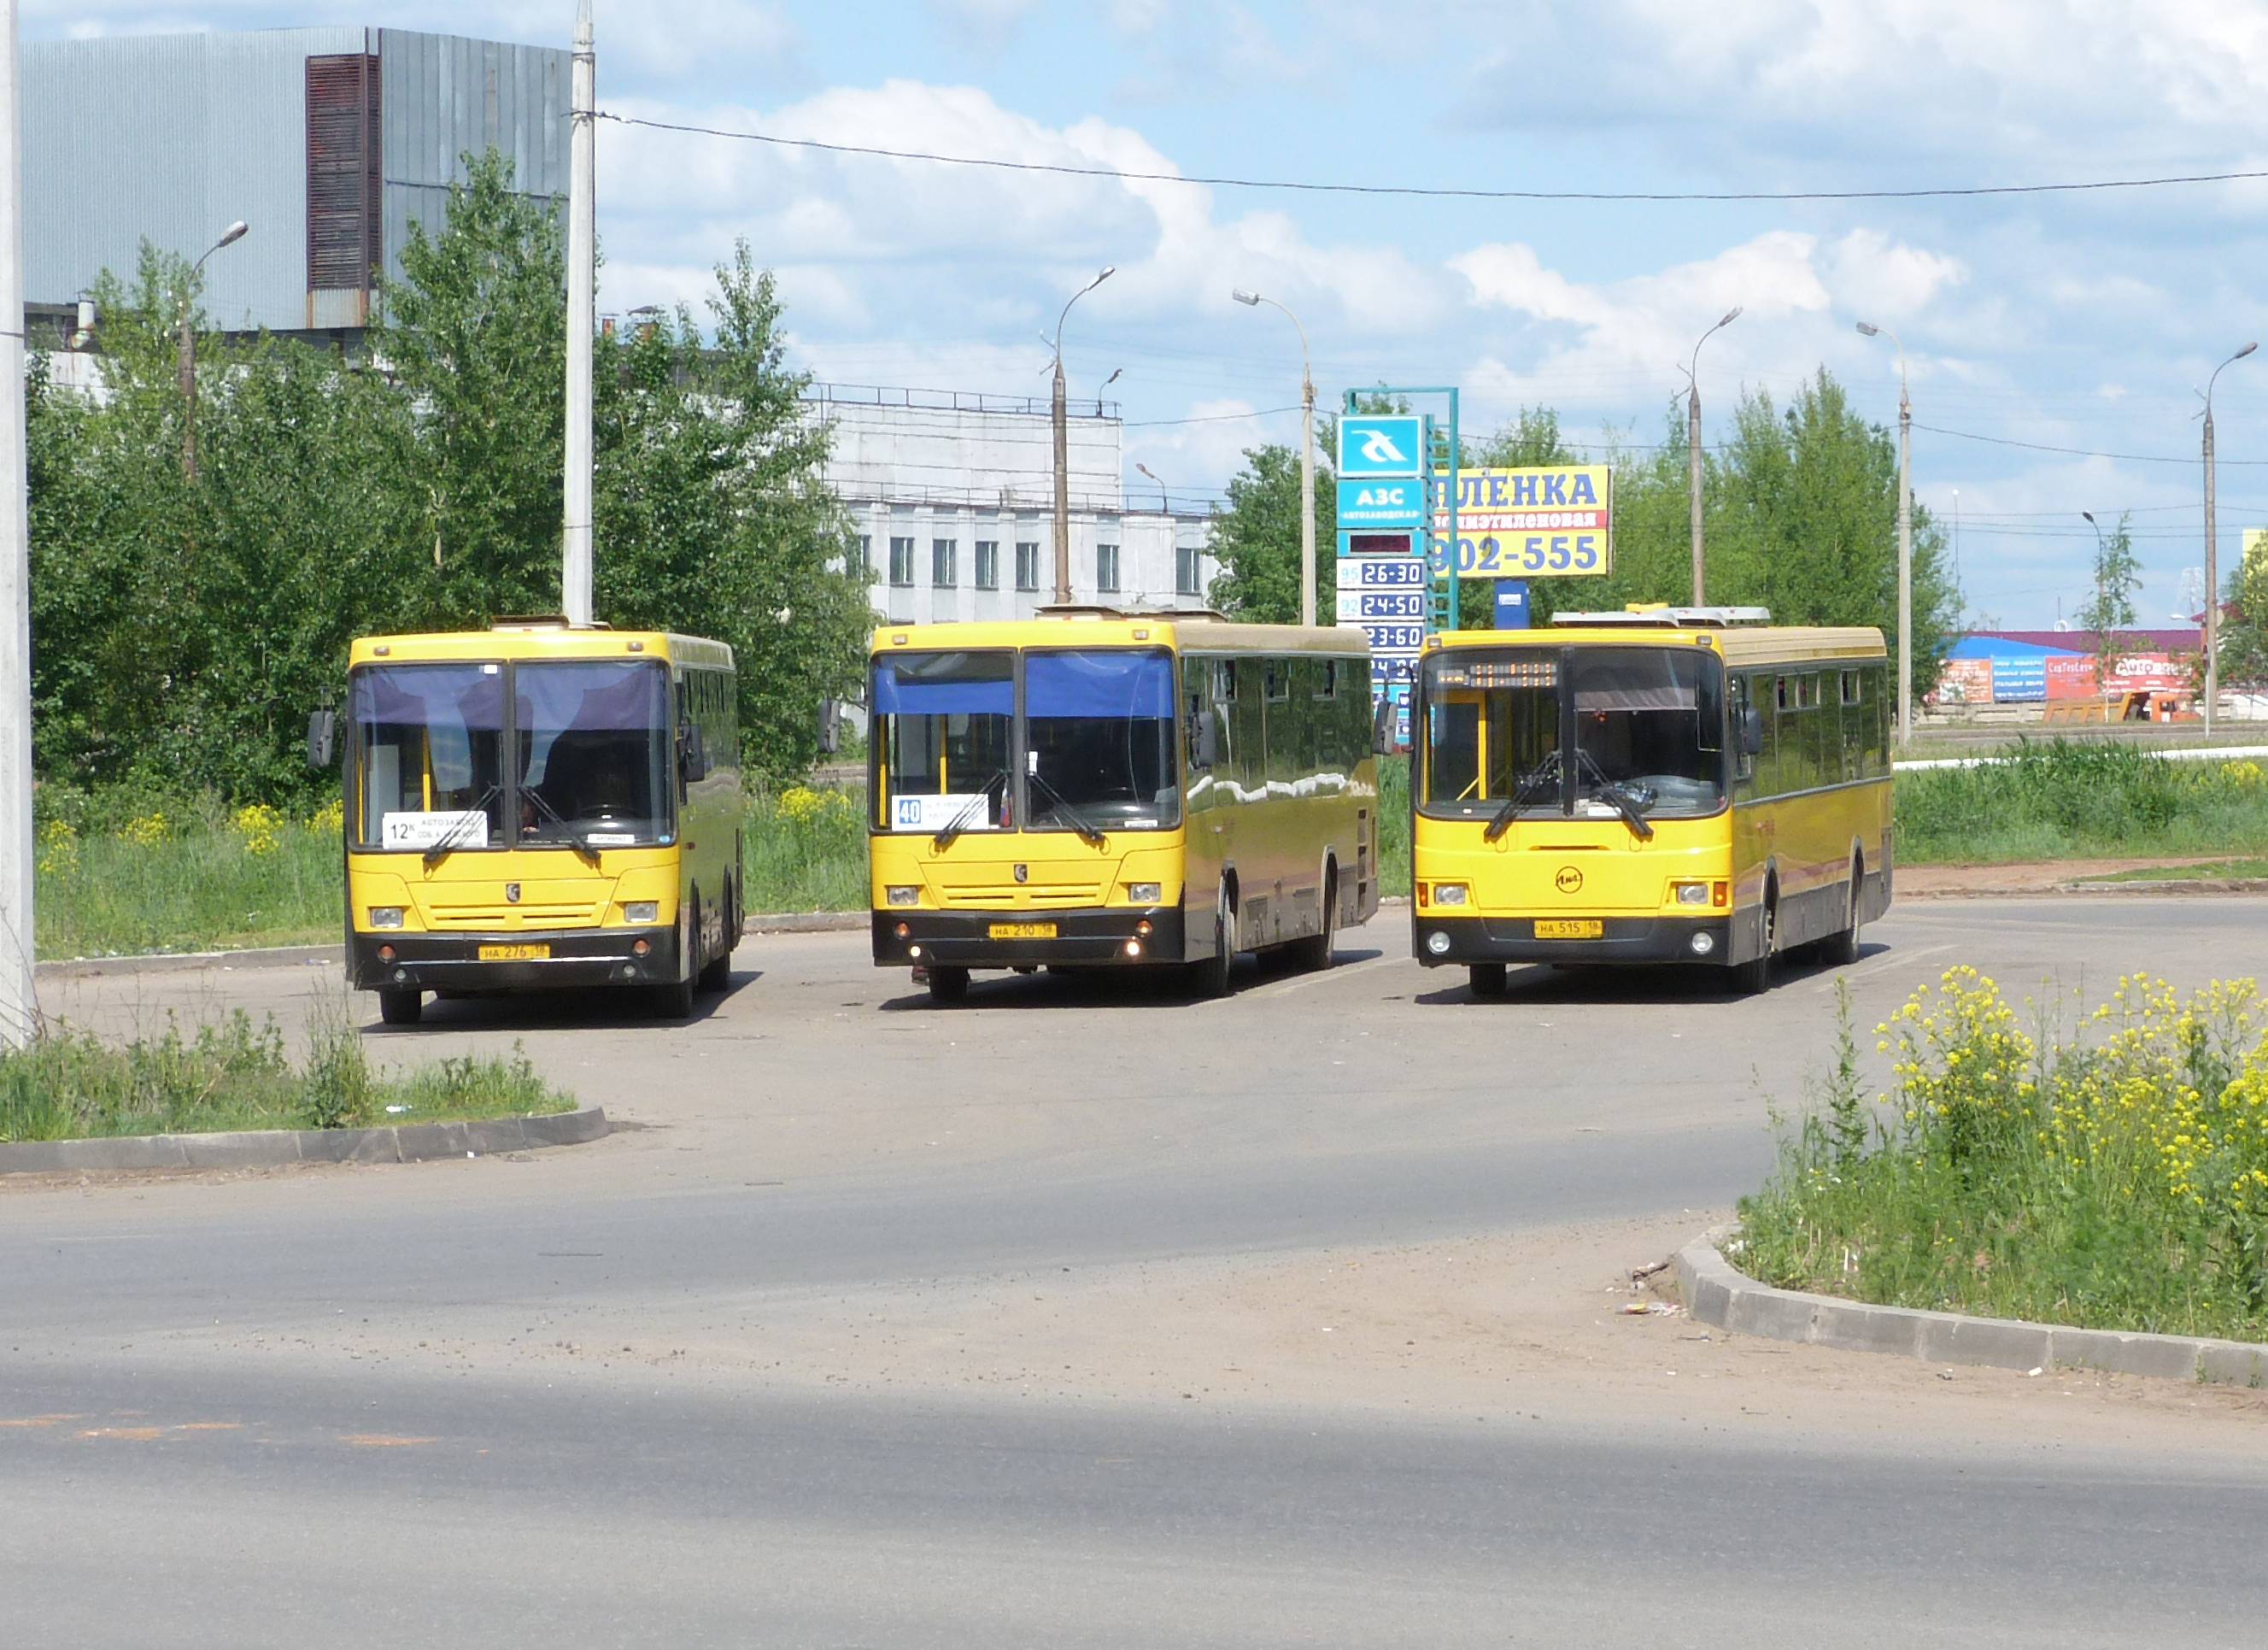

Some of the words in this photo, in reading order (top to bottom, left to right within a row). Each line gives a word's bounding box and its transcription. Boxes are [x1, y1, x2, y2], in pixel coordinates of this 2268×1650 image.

[1357, 489, 1404, 506] АЗС
[1364, 565, 1420, 583] 26-30
[1363, 596, 1420, 614] 24-50
[1559, 922, 1580, 933] 515
